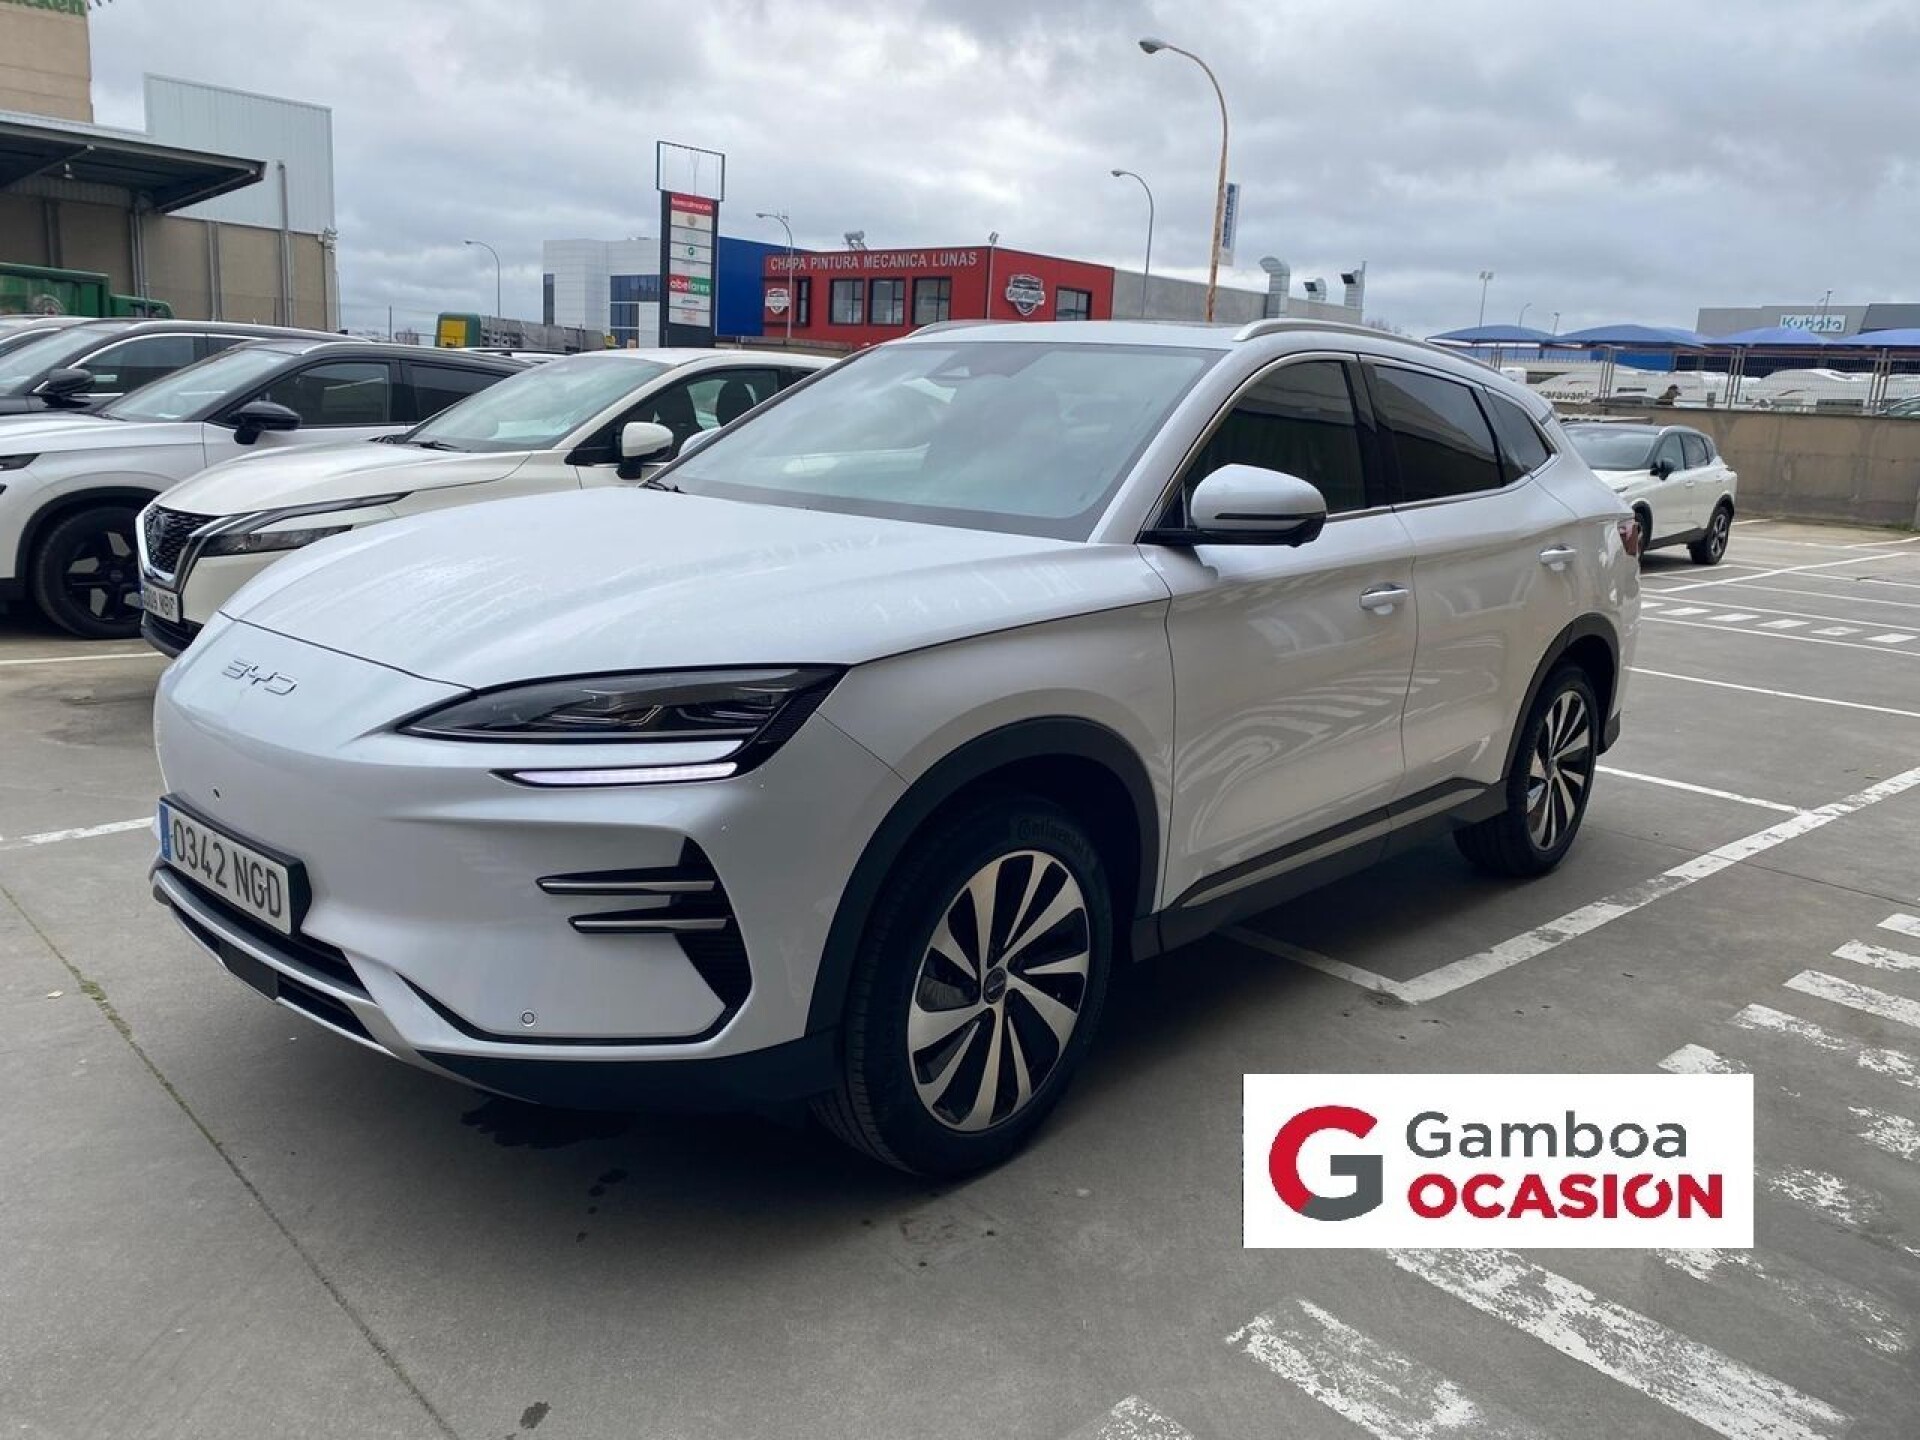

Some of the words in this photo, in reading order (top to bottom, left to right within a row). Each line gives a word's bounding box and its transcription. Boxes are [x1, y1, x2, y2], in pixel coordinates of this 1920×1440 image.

[770, 257, 806, 270] CHAPA
[810, 255, 859, 269] PINTURA
[863, 254, 927, 268] MECANICA
[932, 251, 977, 267] LUNAS
[1782, 316, 1841, 331] Kubota
[222, 658, 297, 696] BYD
[173, 818, 227, 889] 0342
[234, 851, 281, 918] NGD
